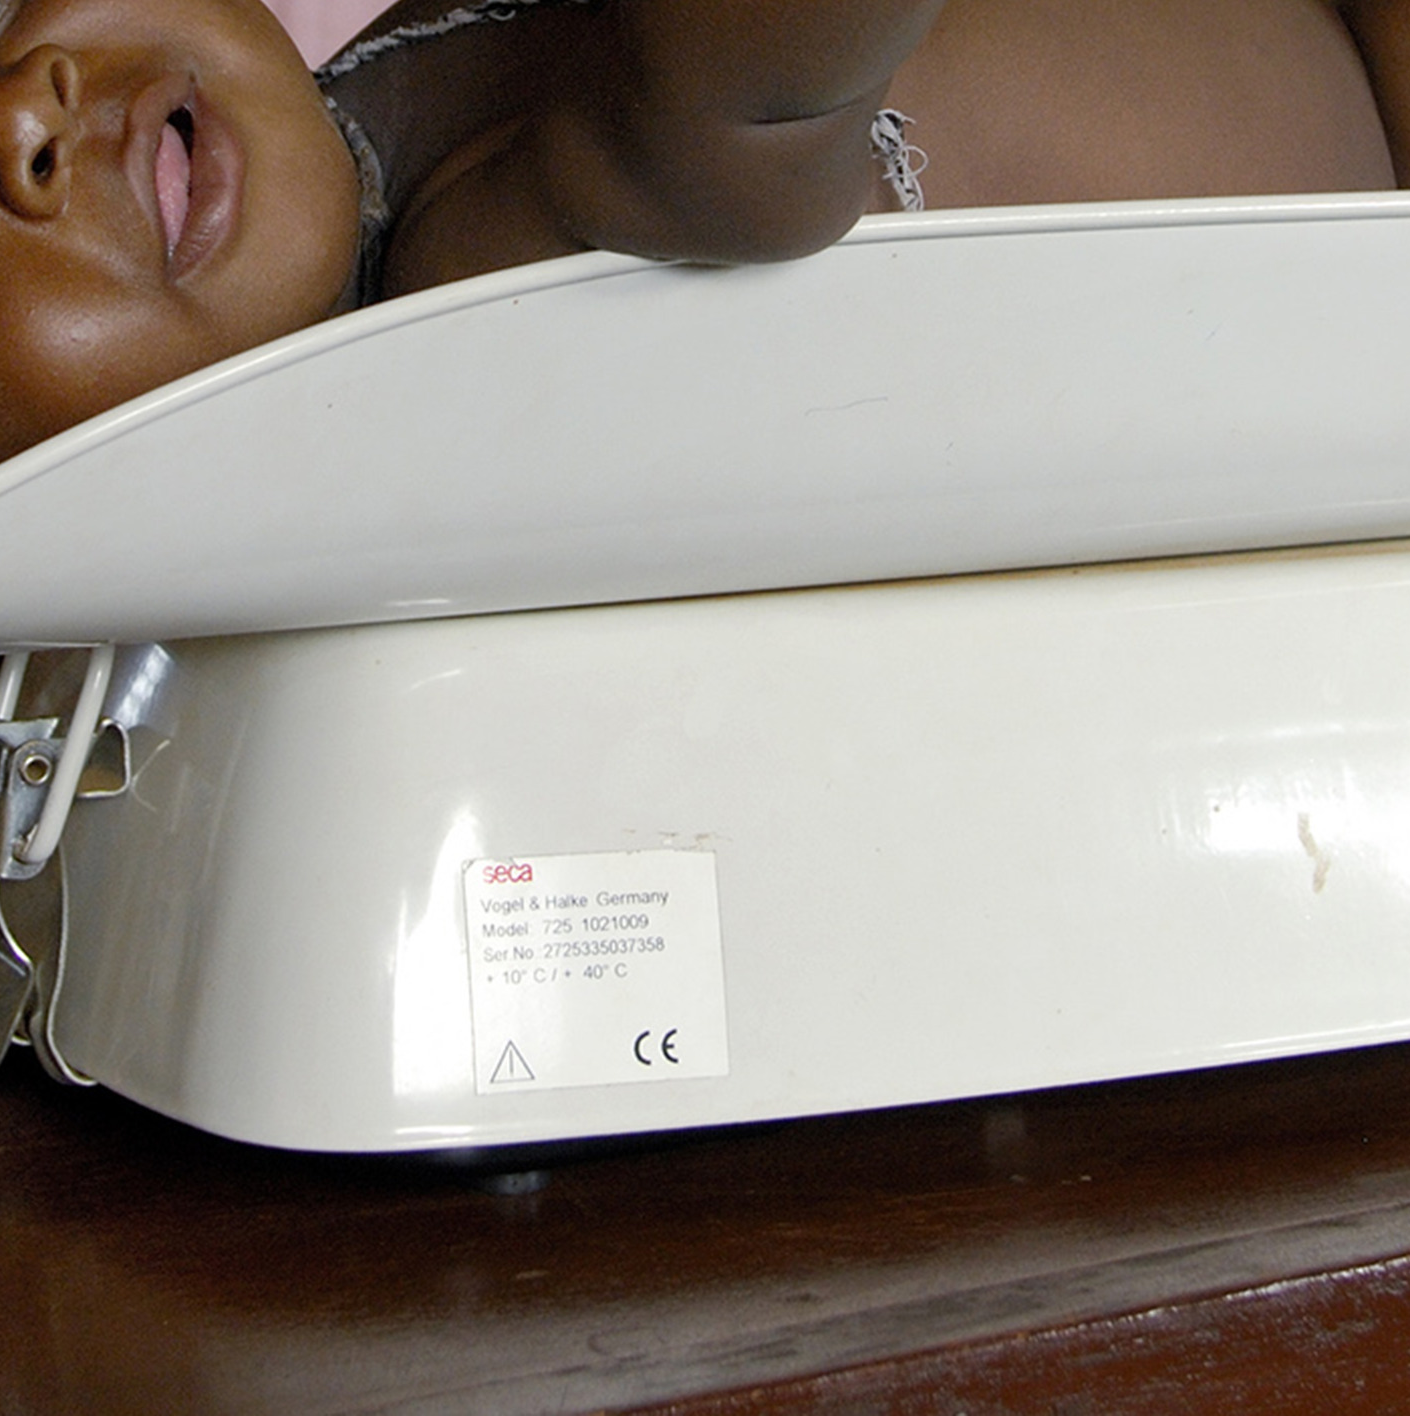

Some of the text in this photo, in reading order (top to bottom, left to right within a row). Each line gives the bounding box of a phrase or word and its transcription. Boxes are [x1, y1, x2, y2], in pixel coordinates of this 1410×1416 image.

[483, 863, 533, 884] seca
[480, 888, 669, 916] Vogel & Halke Germany
[482, 913, 650, 938] Model 725 1021009
[543, 936, 666, 960] 2725335037358
